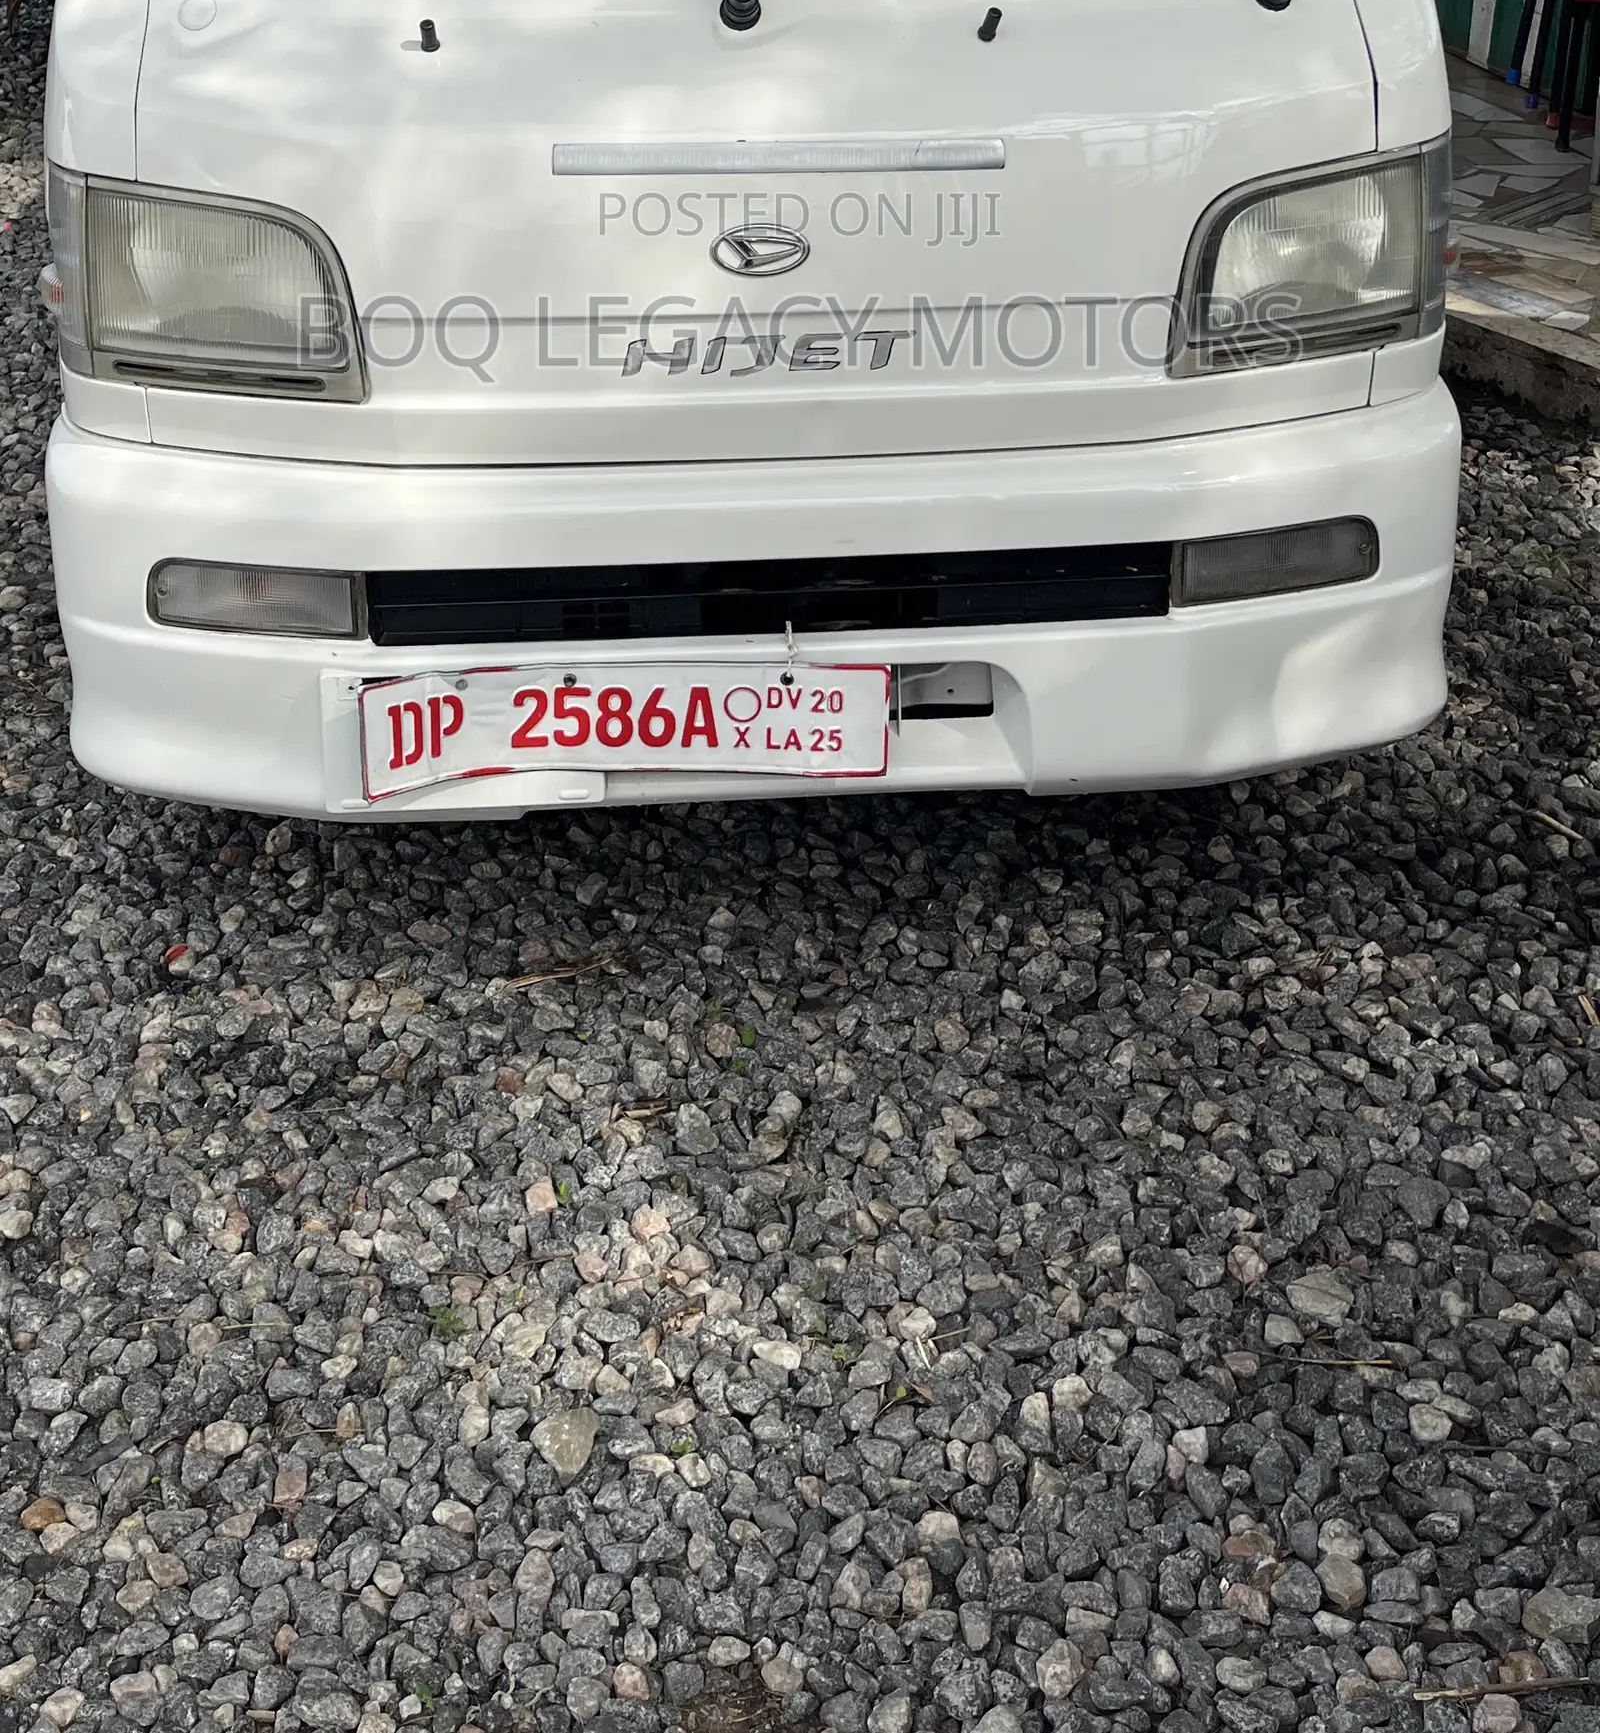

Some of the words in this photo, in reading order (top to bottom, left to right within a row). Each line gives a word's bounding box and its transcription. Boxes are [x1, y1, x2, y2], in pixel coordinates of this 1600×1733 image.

[621, 329, 917, 377] HIJET
[766, 686, 803, 710] DV
[810, 689, 844, 714] 20
[387, 693, 464, 769] DP
[510, 686, 719, 749] 2586A
[733, 726, 751, 748] X
[766, 727, 803, 751] LA
[810, 728, 843, 752] 25
